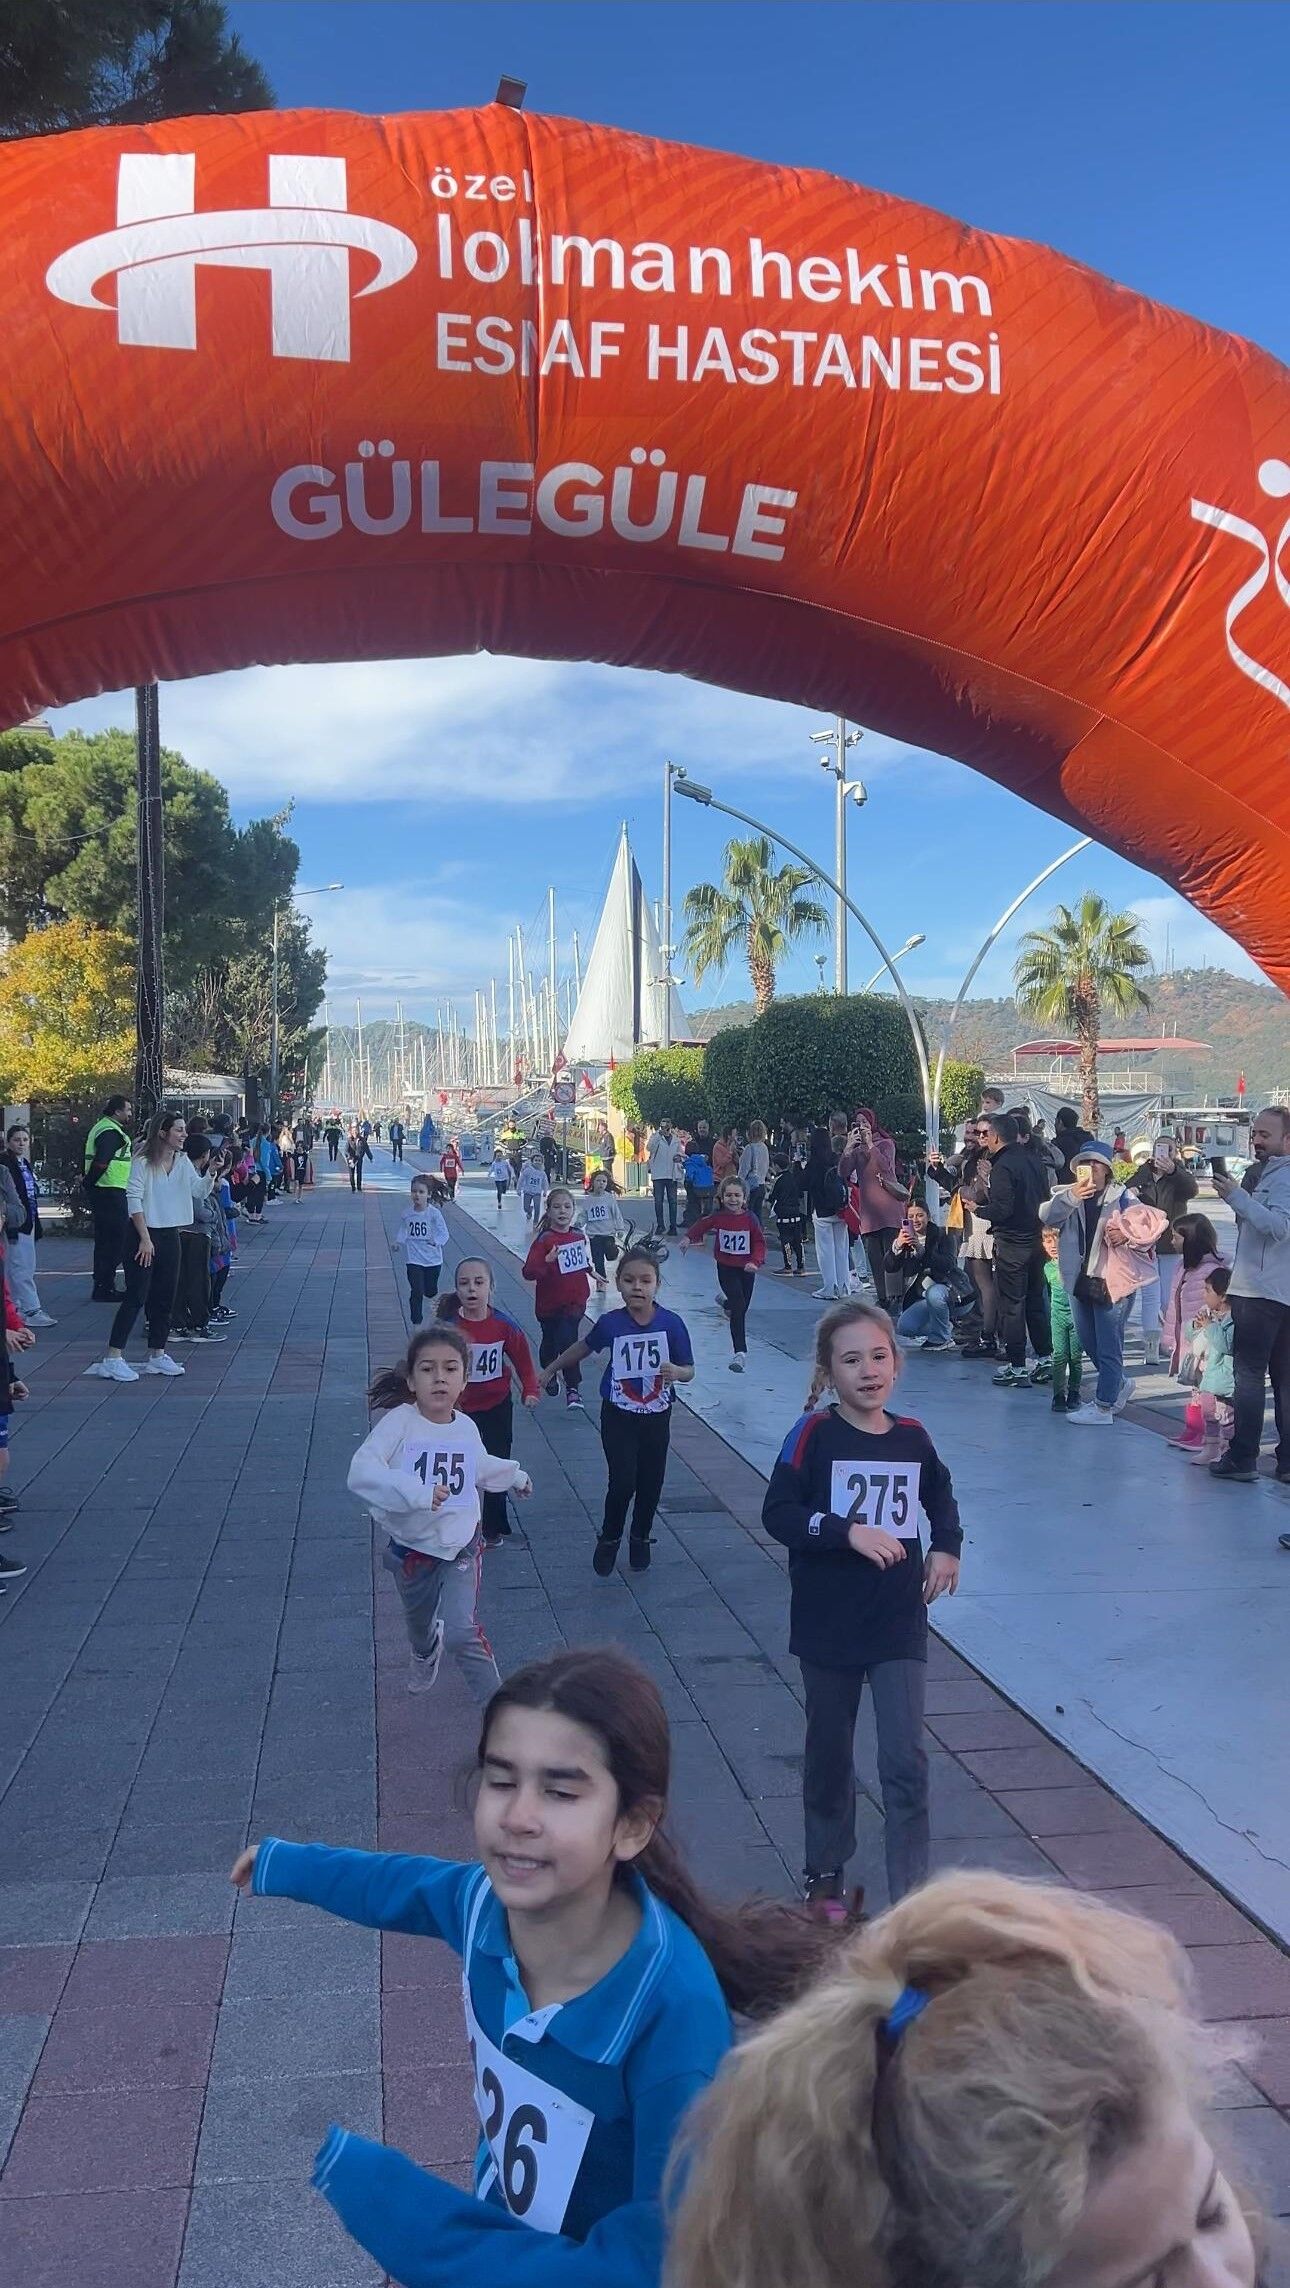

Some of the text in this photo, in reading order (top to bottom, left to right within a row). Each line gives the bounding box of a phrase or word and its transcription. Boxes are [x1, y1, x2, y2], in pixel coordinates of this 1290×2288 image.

[431, 167, 532, 202] özel
[749, 238, 992, 316] hekim
[648, 324, 1001, 395] HASTANESİ
[409, 1222, 427, 1236] 266
[591, 1206, 605, 1218] 186
[560, 1246, 583, 1267] 385
[724, 1235, 745, 1250] 212
[621, 1340, 660, 1371] 175
[414, 1452, 464, 1495] 155
[846, 1474, 908, 1526] 275
[480, 2066, 548, 2216] 26
